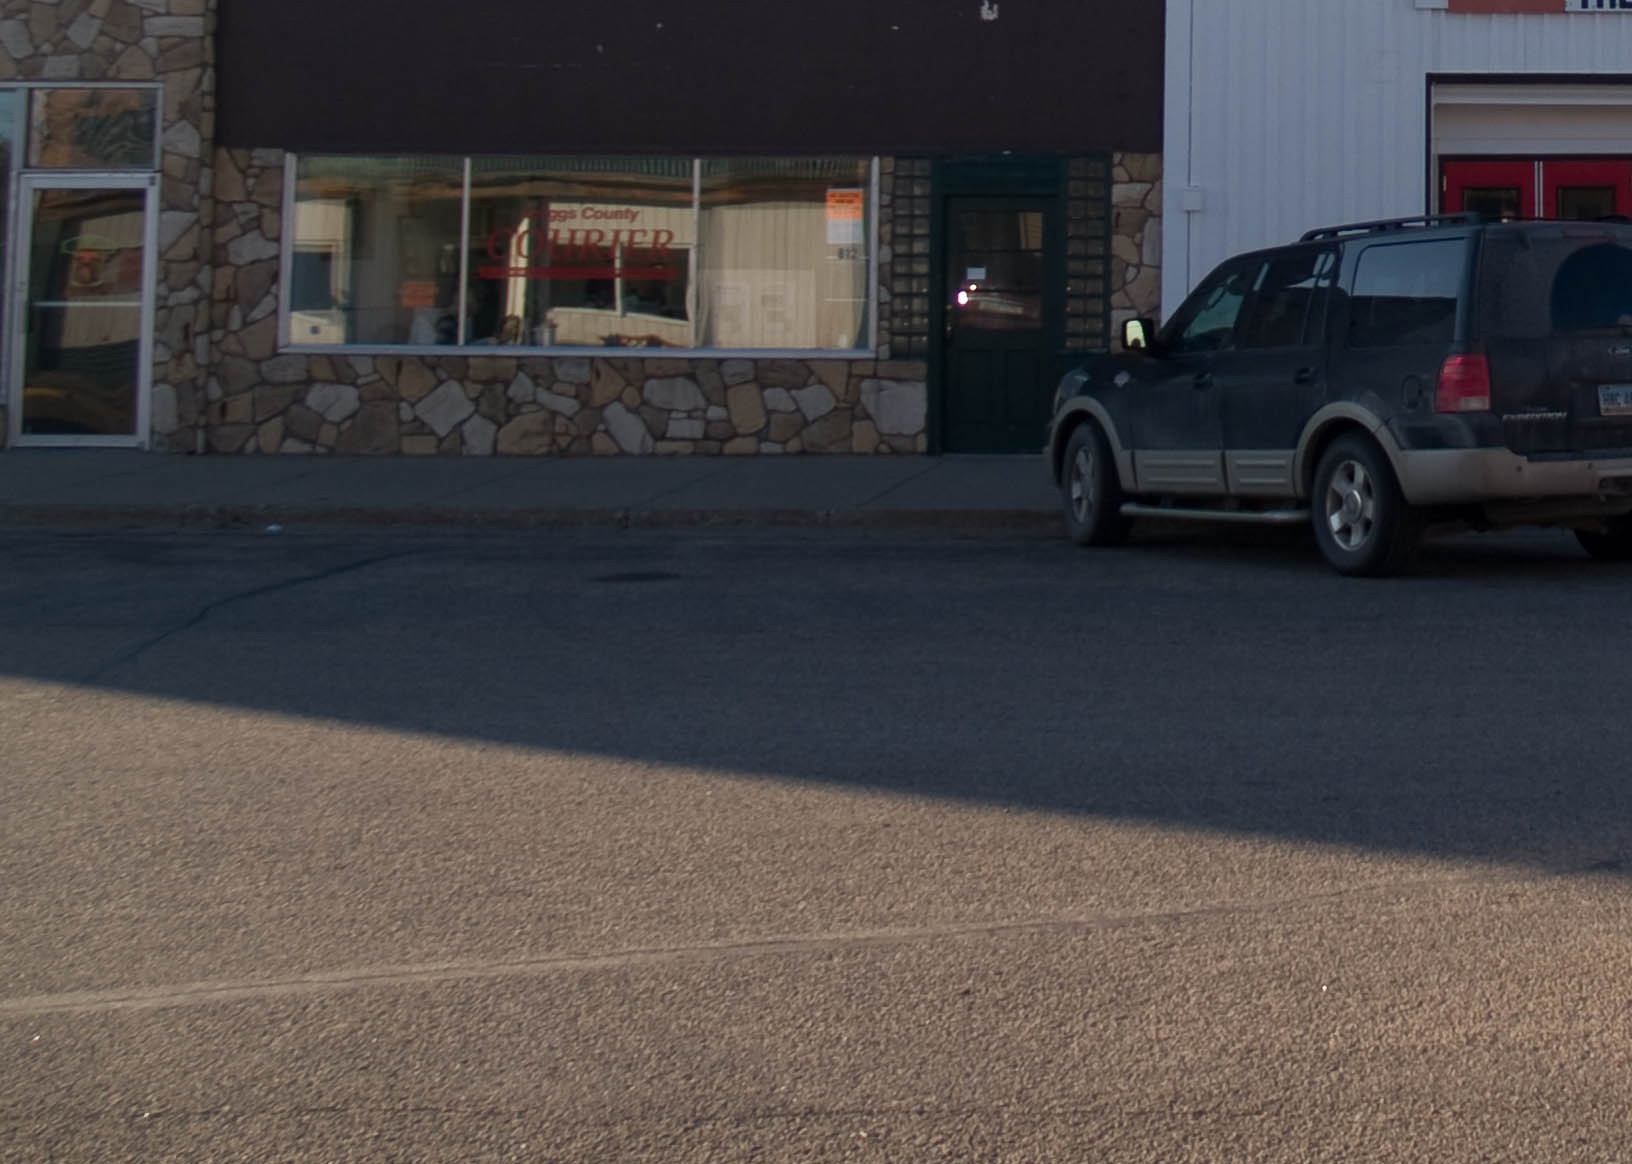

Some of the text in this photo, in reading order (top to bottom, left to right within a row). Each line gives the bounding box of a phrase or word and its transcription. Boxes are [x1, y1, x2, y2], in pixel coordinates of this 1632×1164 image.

[524, 206, 640, 223] ggs County
[486, 227, 675, 261] COURIER
